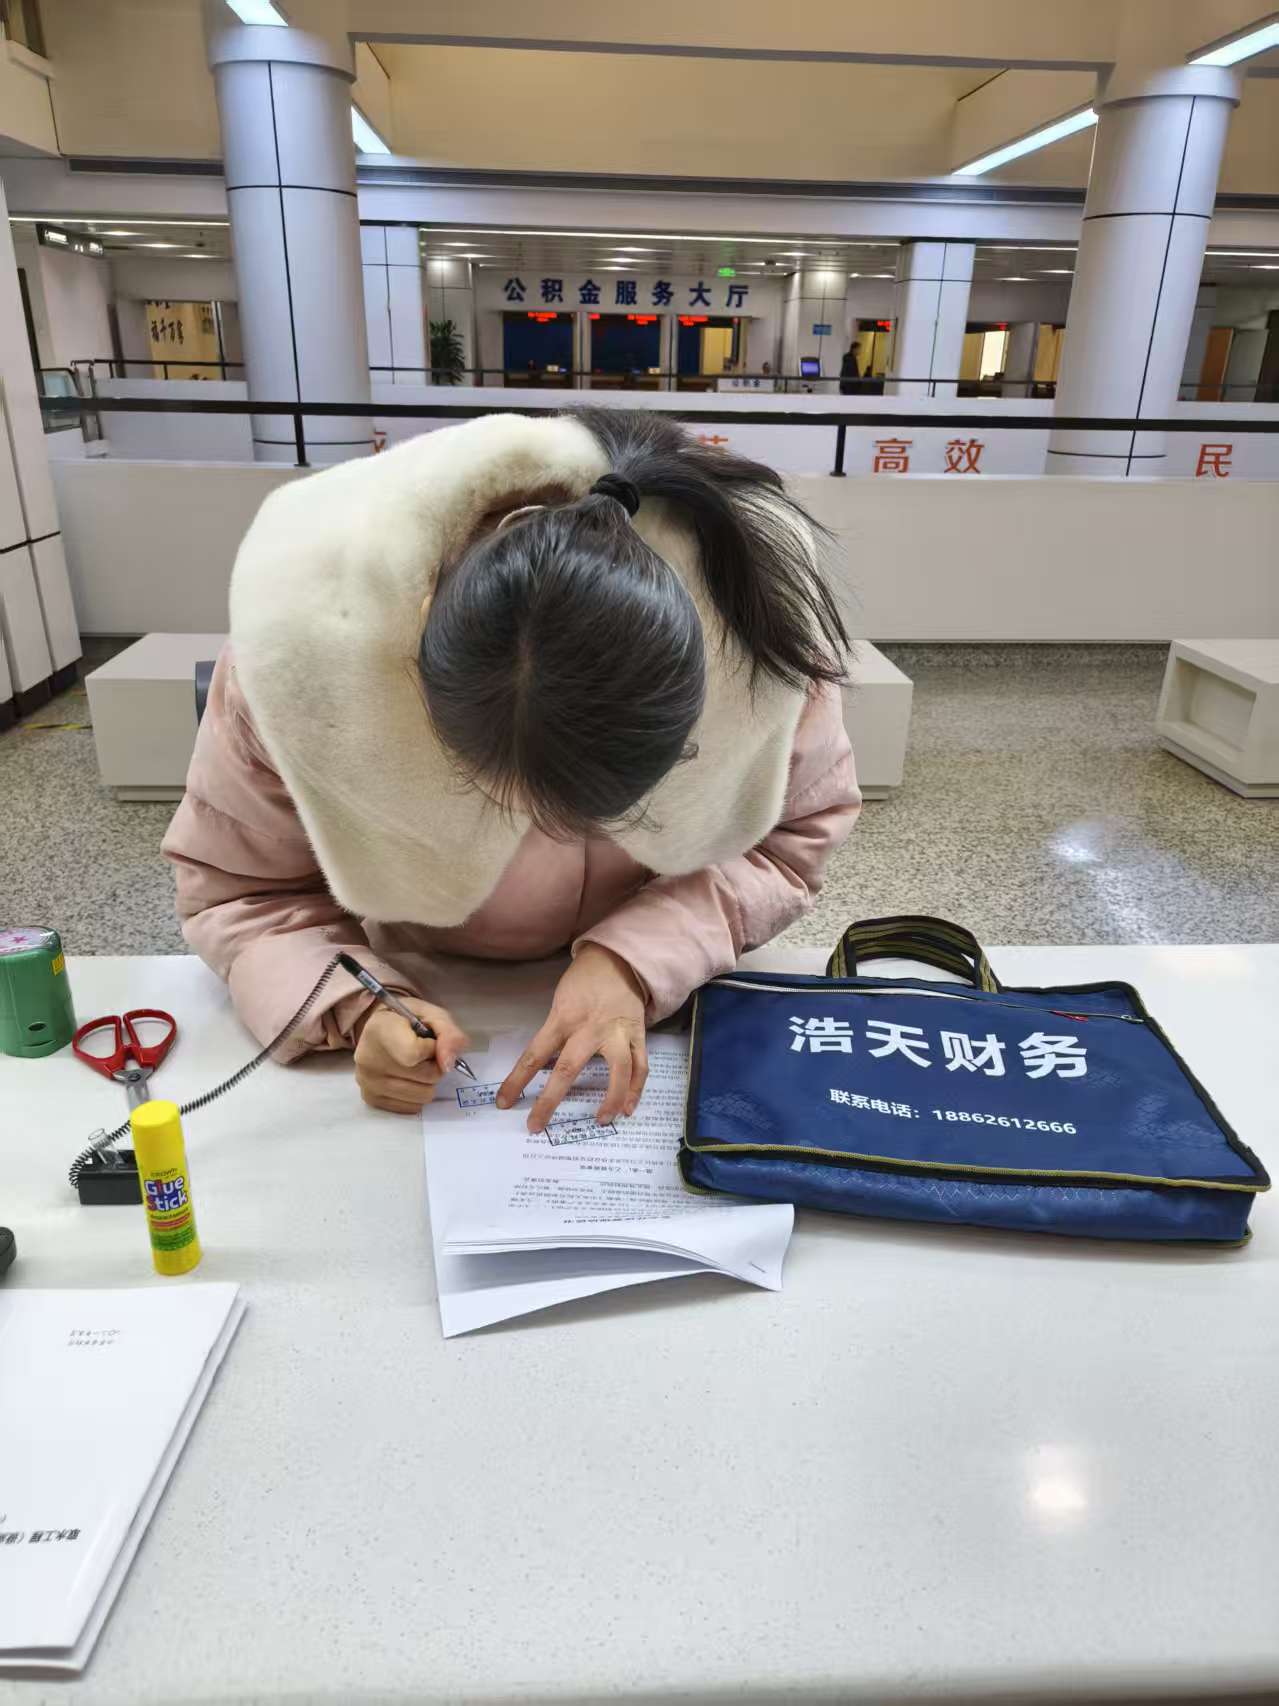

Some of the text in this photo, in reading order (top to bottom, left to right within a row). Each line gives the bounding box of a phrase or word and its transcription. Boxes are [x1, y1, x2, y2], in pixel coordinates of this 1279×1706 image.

[504, 277, 749, 308] 公积金服务大厅
[873, 438, 1233, 477] 高效 民
[788, 1016, 1088, 1079] 浩天财务
[144, 1176, 185, 1196] Glue
[147, 1190, 188, 1211] Stick
